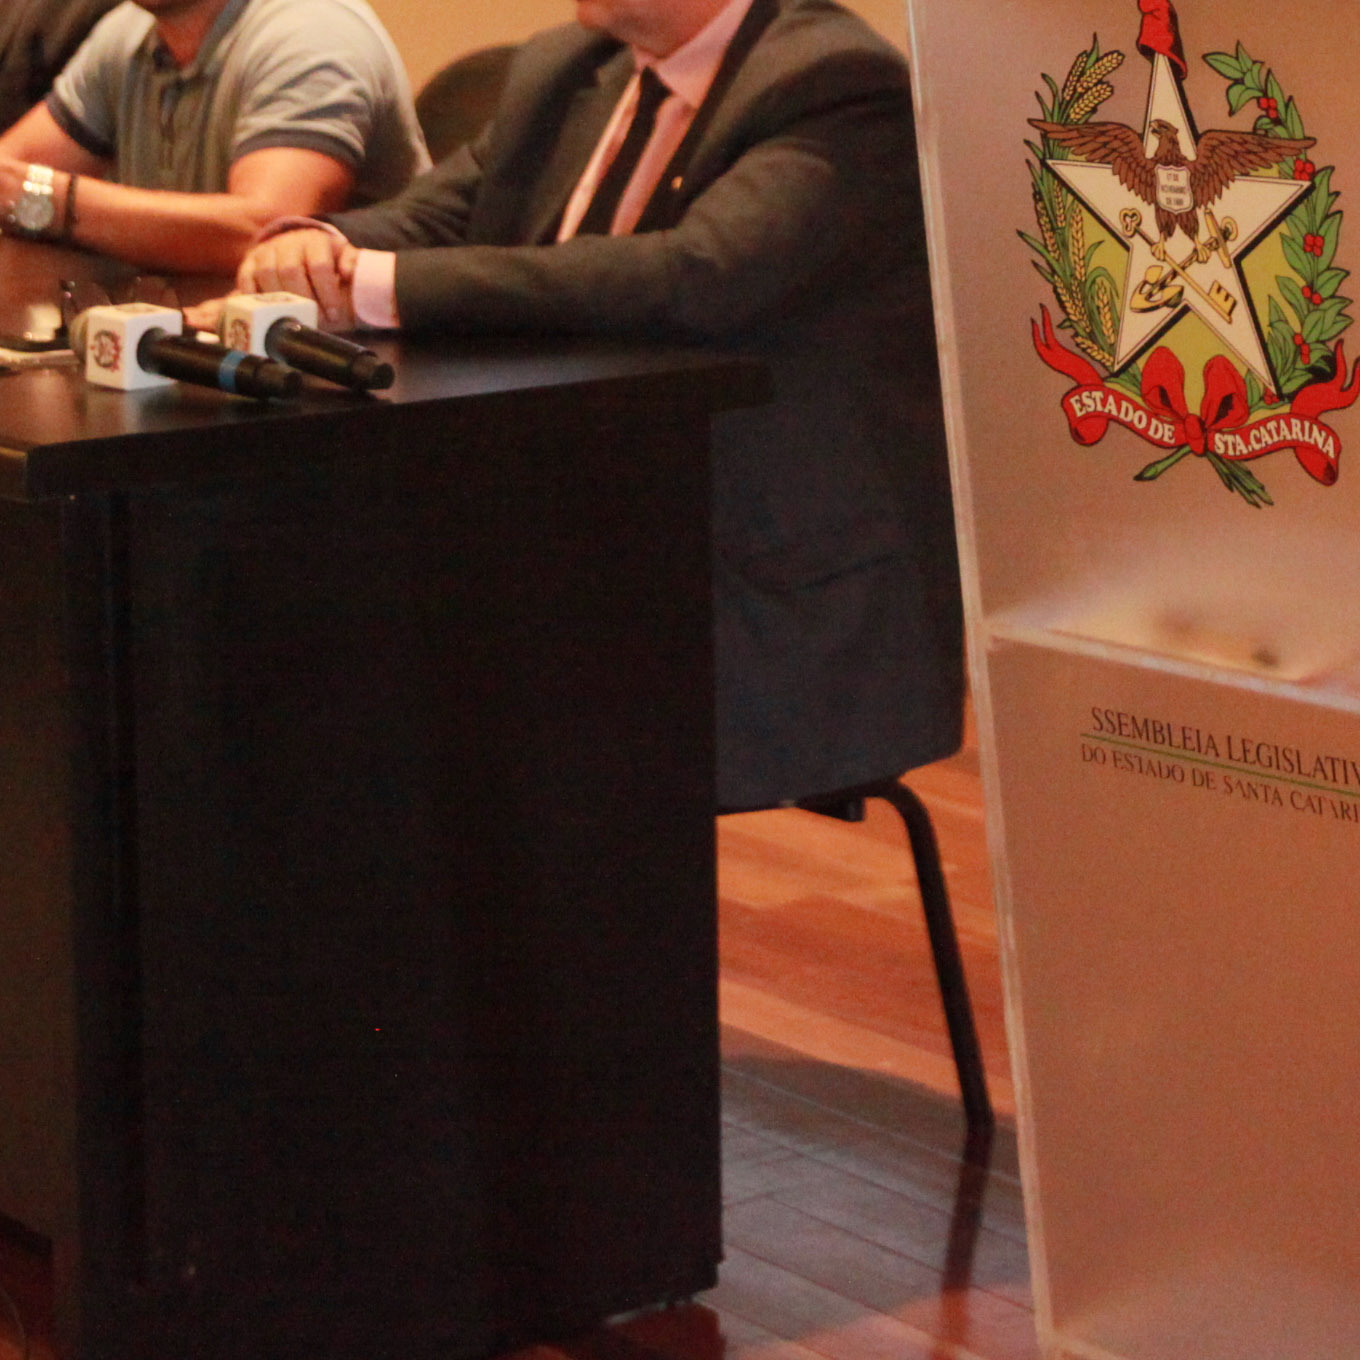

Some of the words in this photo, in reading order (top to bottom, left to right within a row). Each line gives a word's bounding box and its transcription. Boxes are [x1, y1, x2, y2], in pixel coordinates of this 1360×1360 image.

[1070, 390, 1147, 429] ESTADO
[1147, 417, 1176, 444] DE
[1081, 743, 1106, 765] DO
[1111, 750, 1185, 784] ESTADO
[1191, 767, 1217, 790] DE
[1223, 775, 1283, 807] SANTA
